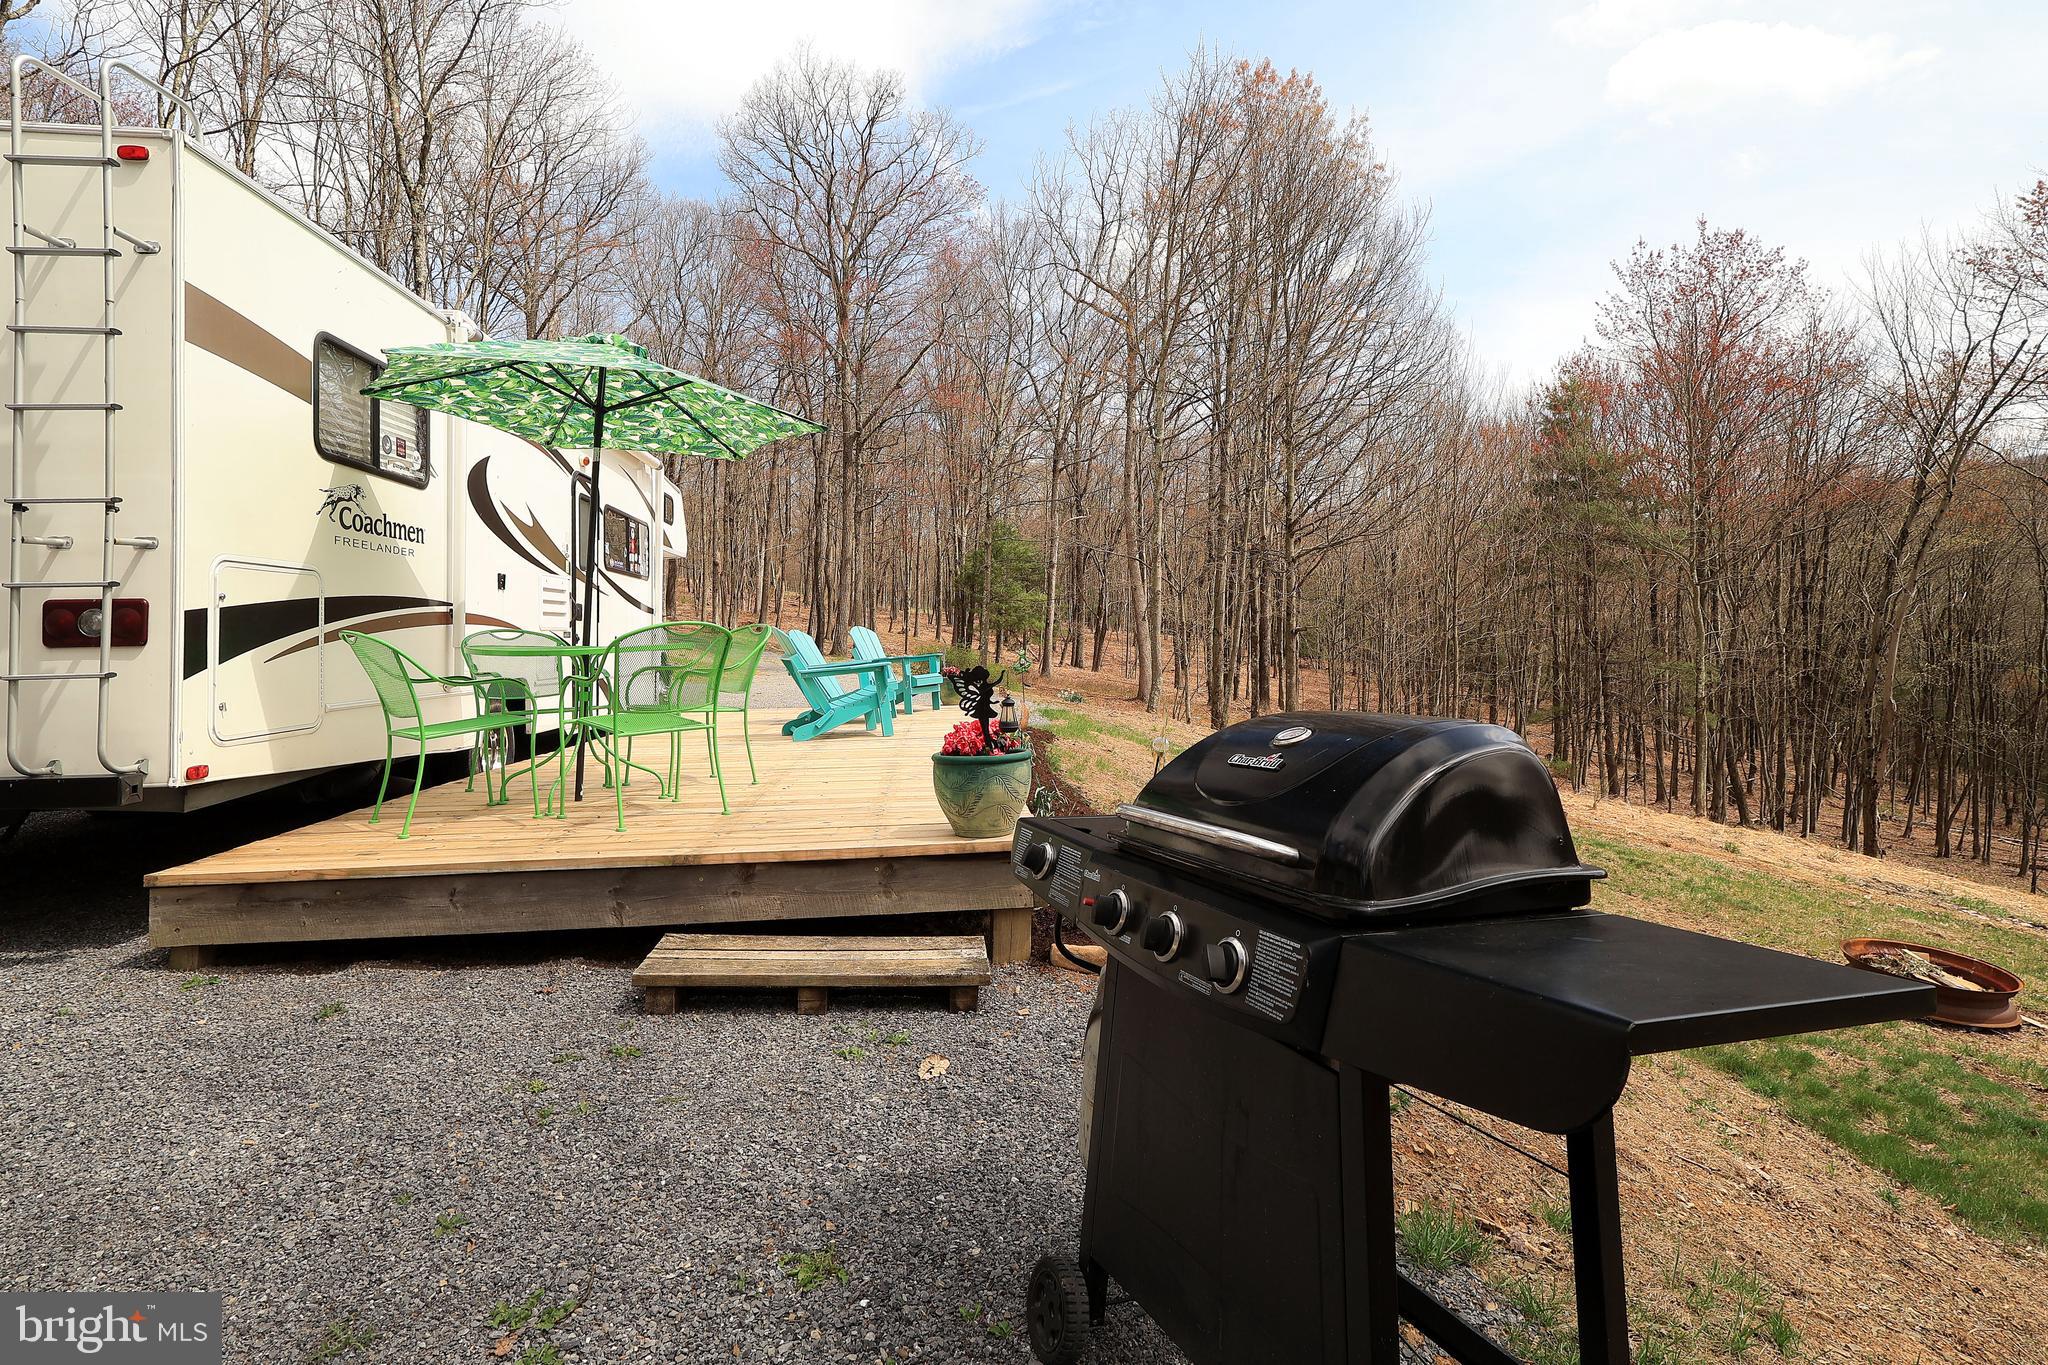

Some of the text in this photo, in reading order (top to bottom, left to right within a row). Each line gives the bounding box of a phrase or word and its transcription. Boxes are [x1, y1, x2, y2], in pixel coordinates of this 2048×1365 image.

[338, 506, 425, 545] Coachmen
[334, 535, 415, 557] FREELANDER
[1227, 753, 1284, 770] Char-Broil
